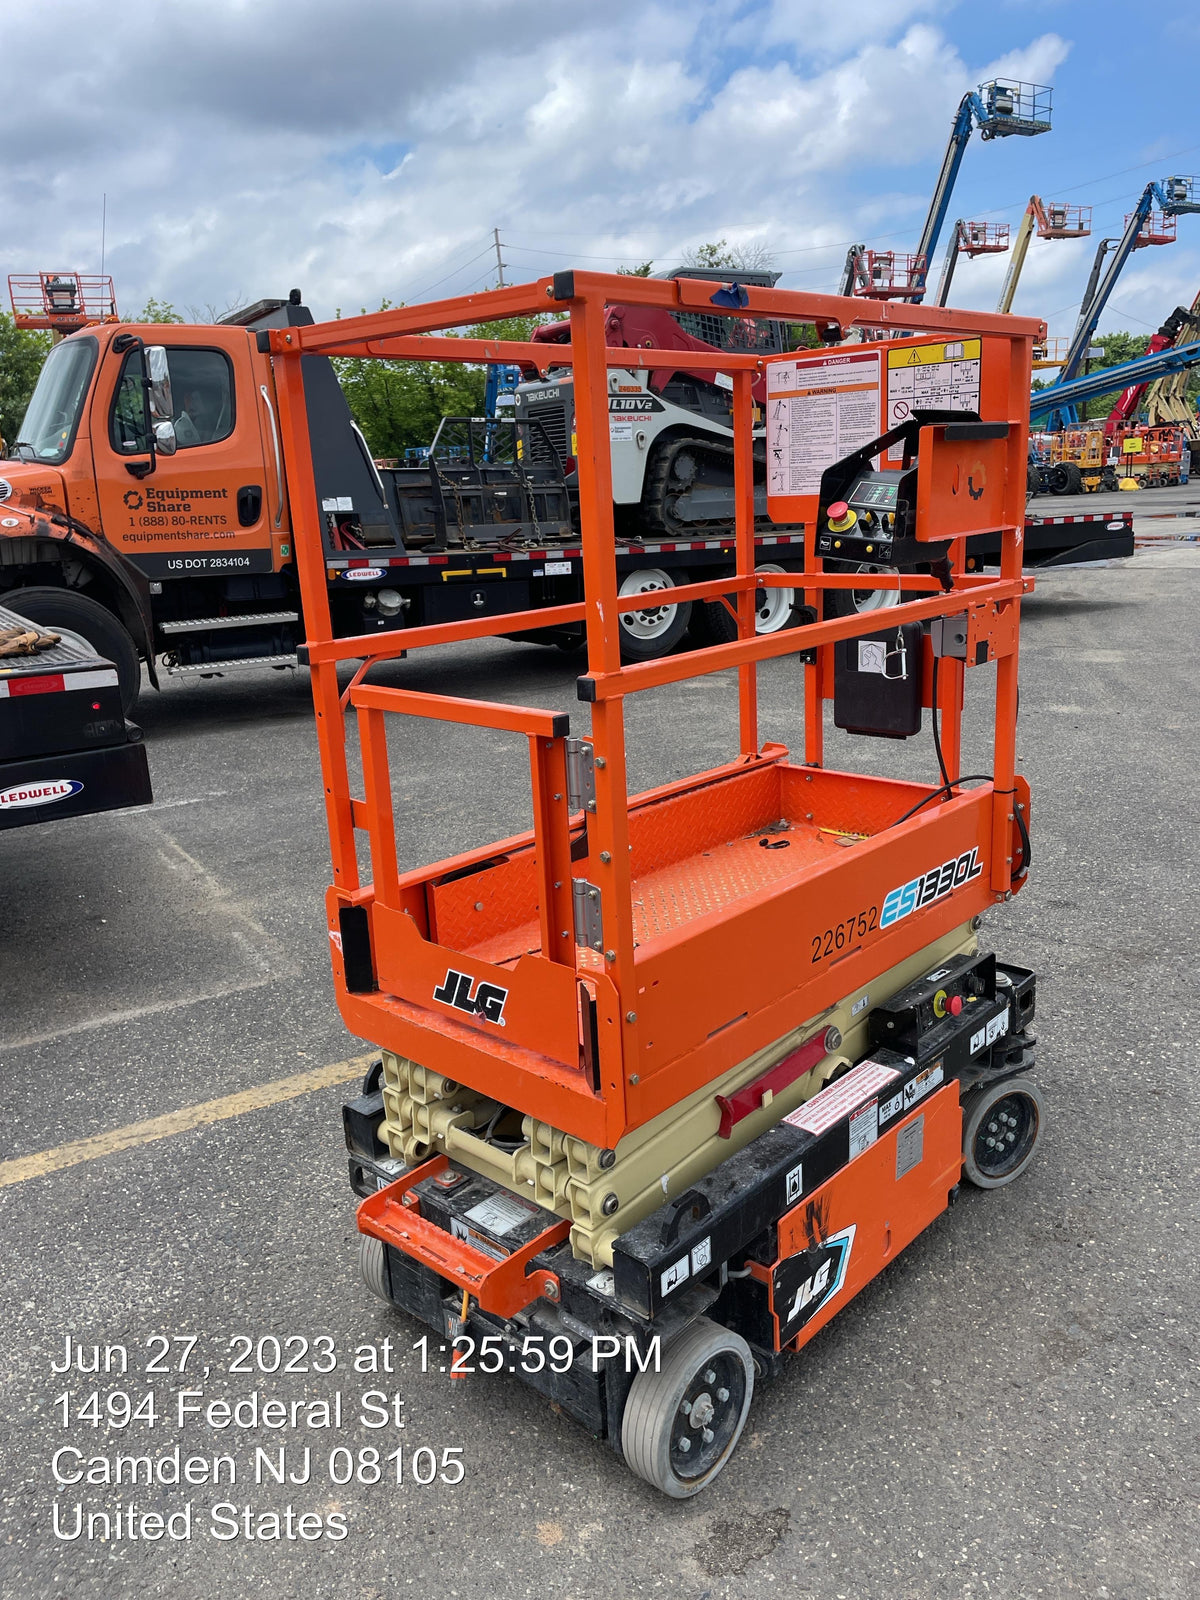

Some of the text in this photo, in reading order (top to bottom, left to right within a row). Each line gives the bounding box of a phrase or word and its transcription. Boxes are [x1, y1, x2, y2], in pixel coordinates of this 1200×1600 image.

[526, 388, 560, 402] TAKEUCHI
[812, 388, 836, 396] WARNING
[145, 488, 228, 501] Equipment
[147, 501, 191, 513] Share
[129, 515, 227, 527] 1 (888) 80-RENTS
[122, 530, 236, 544] equipmentshare.com
[168, 557, 250, 570] US DOT 2834104
[1, 785, 67, 803] LEDWELL
[811, 846, 983, 964] 226752 ES1330L
[432, 968, 509, 1026] JLG
[806, 1061, 873, 1108] CUSTOMER RESPONSIBILITY
[881, 1102, 892, 1113] MAX
[787, 1257, 831, 1322] JLG
